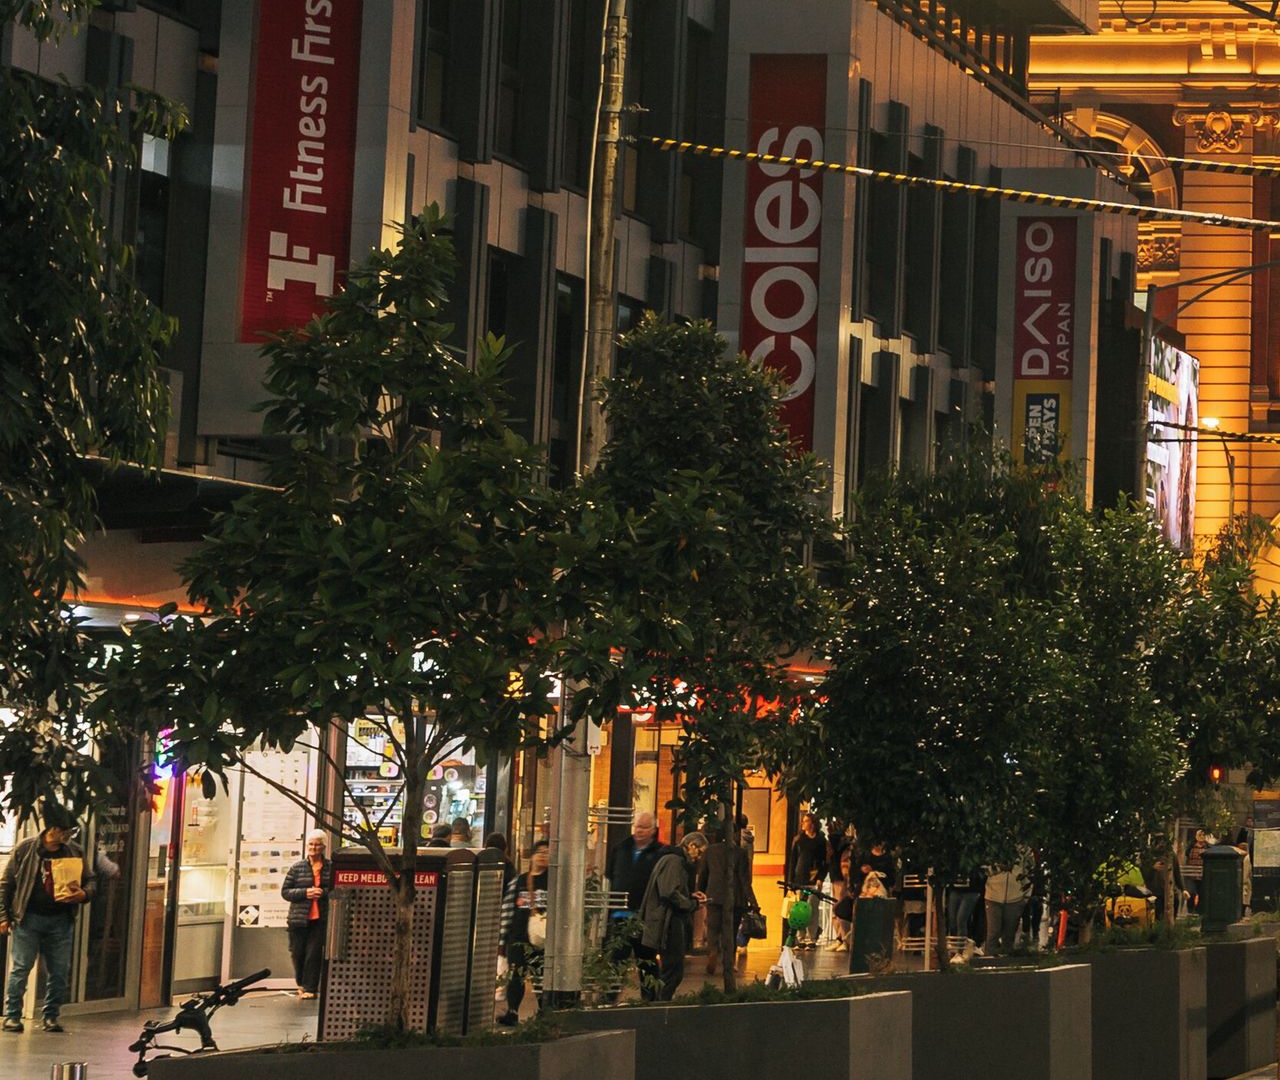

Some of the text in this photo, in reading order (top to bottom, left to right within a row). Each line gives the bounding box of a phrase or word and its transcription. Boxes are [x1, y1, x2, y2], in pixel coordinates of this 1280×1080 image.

[283, 74, 328, 214] Fitness
[745, 125, 824, 401] coles
[1021, 221, 1054, 377] DAISO
[1055, 303, 1072, 376] JAPAN
[338, 873, 359, 883] KEEP
[414, 874, 436, 885] LEAN
